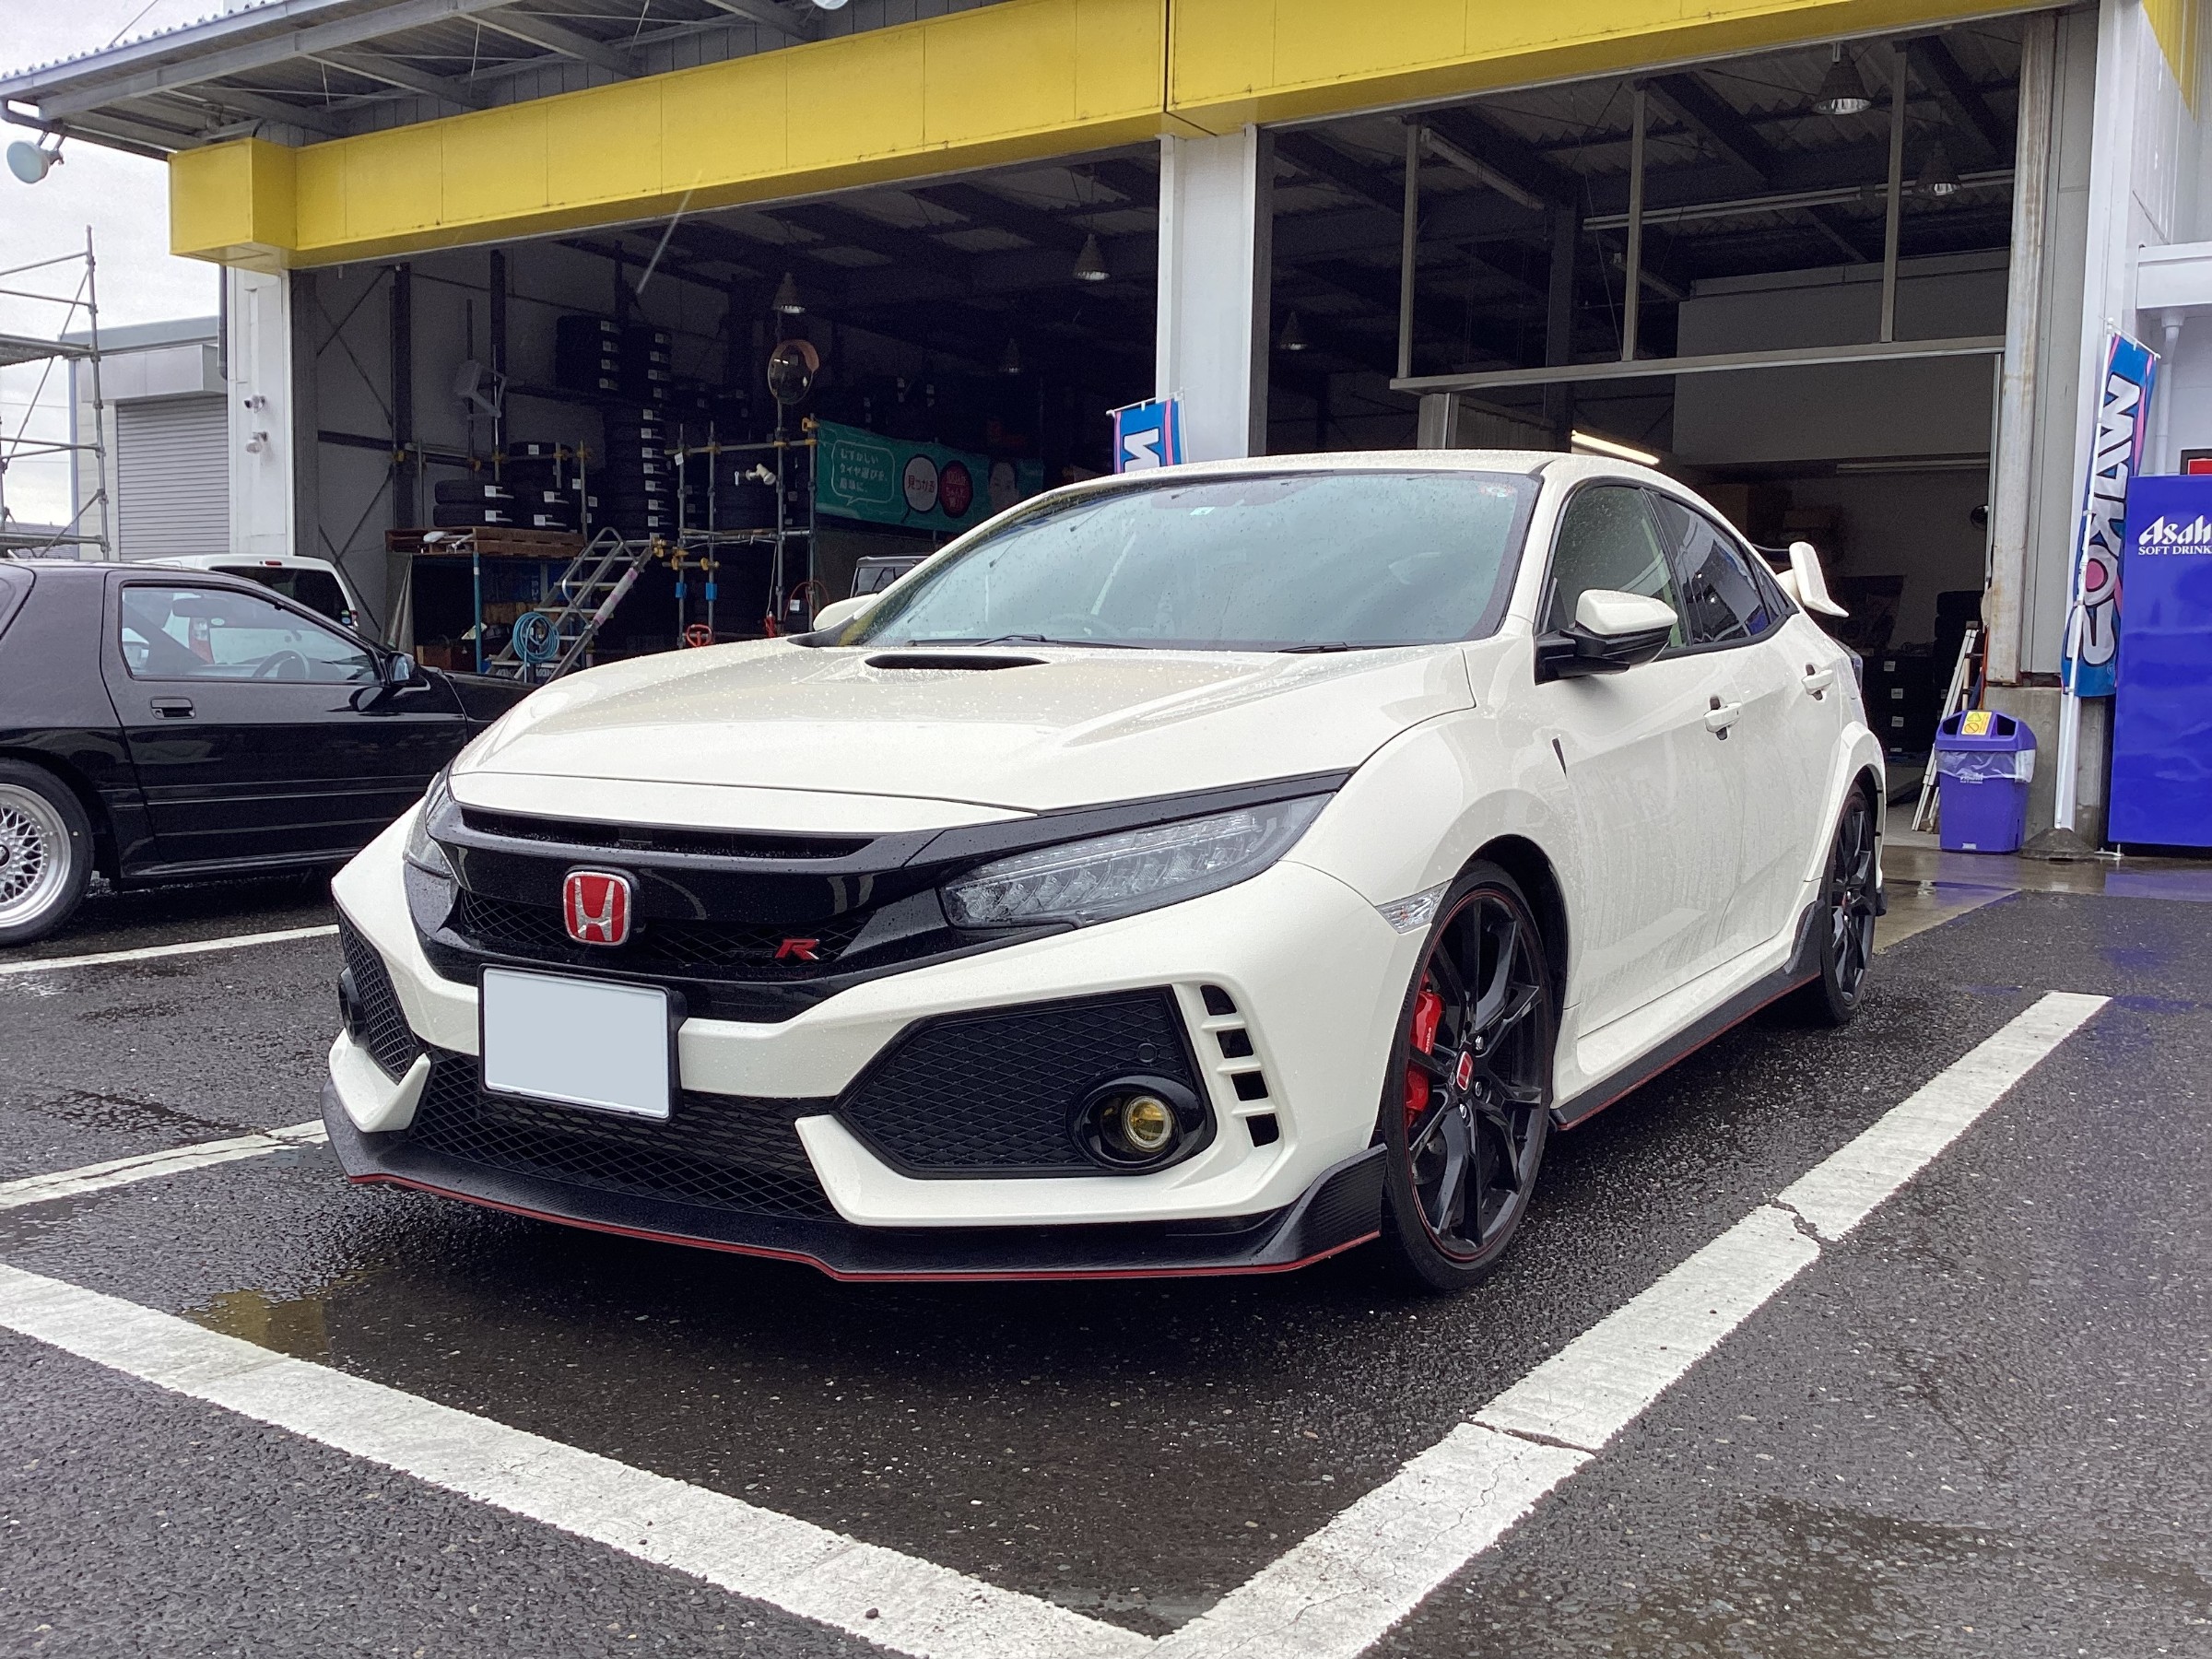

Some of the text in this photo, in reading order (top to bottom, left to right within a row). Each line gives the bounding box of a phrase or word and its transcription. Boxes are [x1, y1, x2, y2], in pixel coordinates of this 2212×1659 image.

[908, 475, 935, 493] 見つかる
[2138, 546, 2170, 555] SOFT
[774, 937, 820, 961] R
